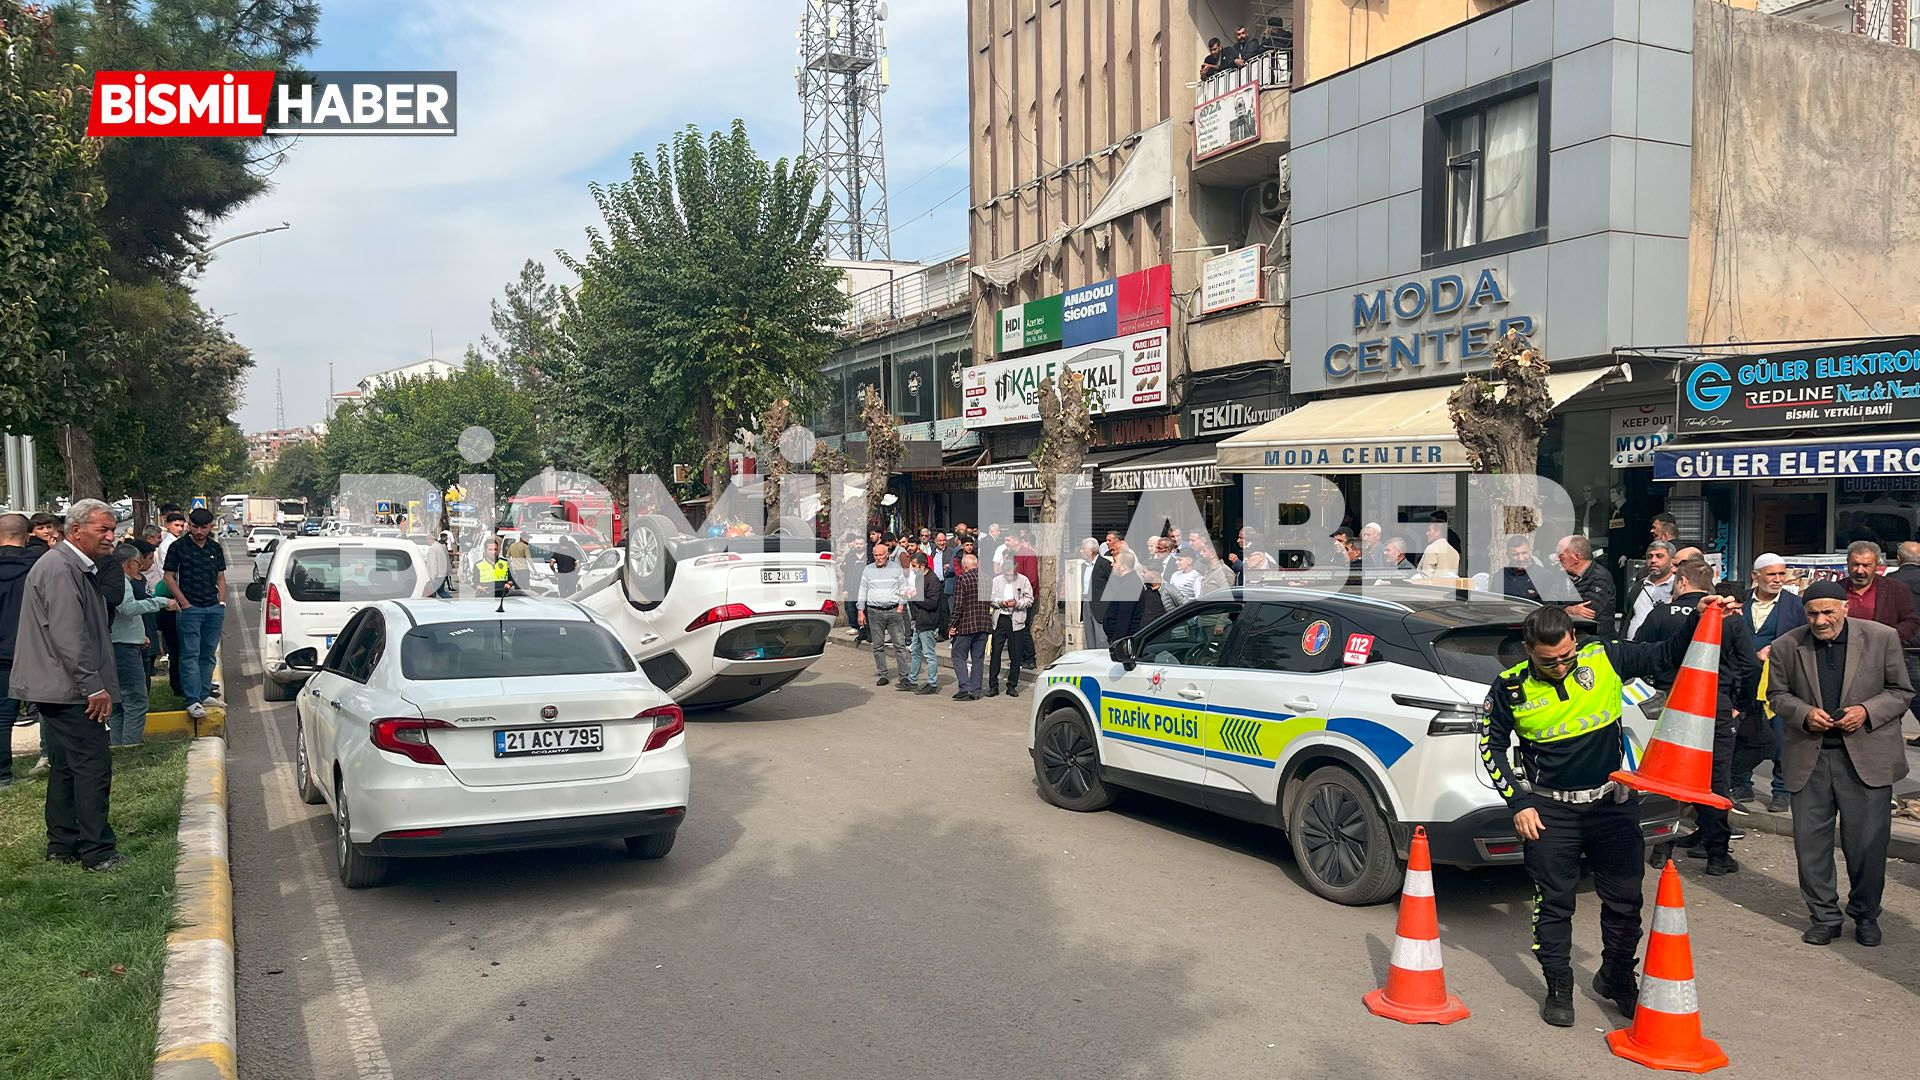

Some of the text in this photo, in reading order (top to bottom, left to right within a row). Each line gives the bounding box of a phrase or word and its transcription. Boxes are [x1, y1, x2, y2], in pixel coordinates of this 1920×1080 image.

[1064, 284, 1114, 308] ANADOLU
[1354, 269, 1511, 329] MODA
[1063, 302, 1108, 323] SİGORTA
[1005, 317, 1021, 333] HDI
[1324, 314, 1535, 377] CENTER
[1012, 362, 1056, 404] KALE
[1738, 358, 1808, 386] GÜLER
[1746, 386, 1834, 404] REDLINE
[1622, 415, 1673, 428] KEEP OUT
[1785, 408, 1820, 420] BİSMİL
[1264, 446, 1442, 465] MODA CENTER
[1675, 451, 1770, 478] GÜLER
[1010, 475, 1034, 490] AYKAL
[1109, 471, 1141, 491] TEKİN
[1143, 466, 1223, 489] KUYUMCULUK
[1350, 637, 1370, 653] 112
[1108, 705, 1199, 739] TRAFİK POLİSİ
[506, 733, 526, 751] 21
[531, 730, 564, 748] ACY
[568, 728, 600, 746] 795
